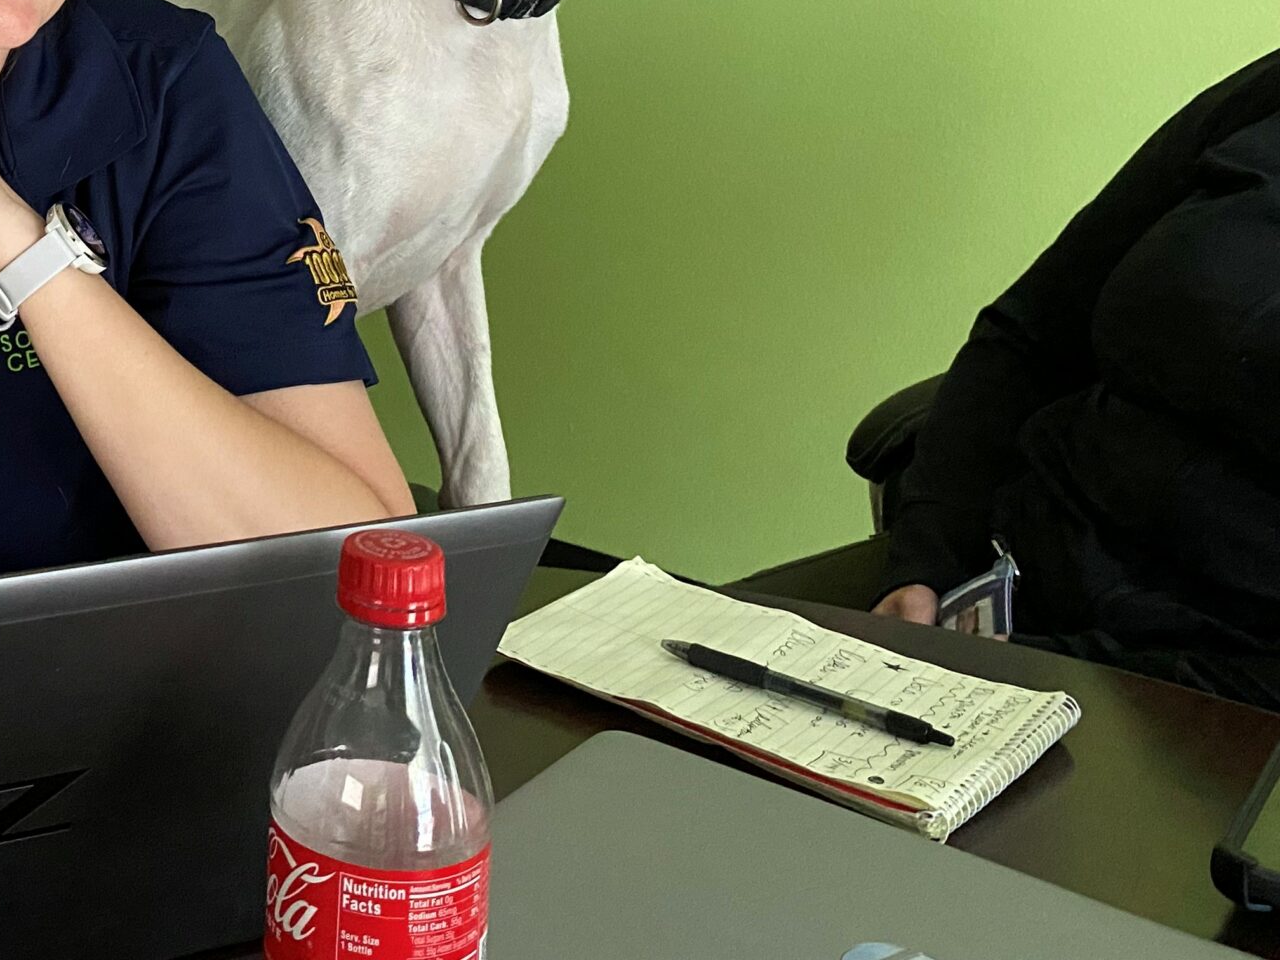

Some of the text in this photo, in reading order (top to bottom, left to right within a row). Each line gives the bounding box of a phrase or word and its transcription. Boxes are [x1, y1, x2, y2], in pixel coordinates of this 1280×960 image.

[342, 877, 406, 900] Nutrition
[342, 894, 381, 915] Facts
[409, 899, 430, 909] Total
[431, 897, 443, 907] Fat
[408, 911, 437, 921] Sodium
[408, 923, 429, 933] Total
[340, 929, 380, 946] Serv. Size
[347, 942, 373, 956] Bottle
